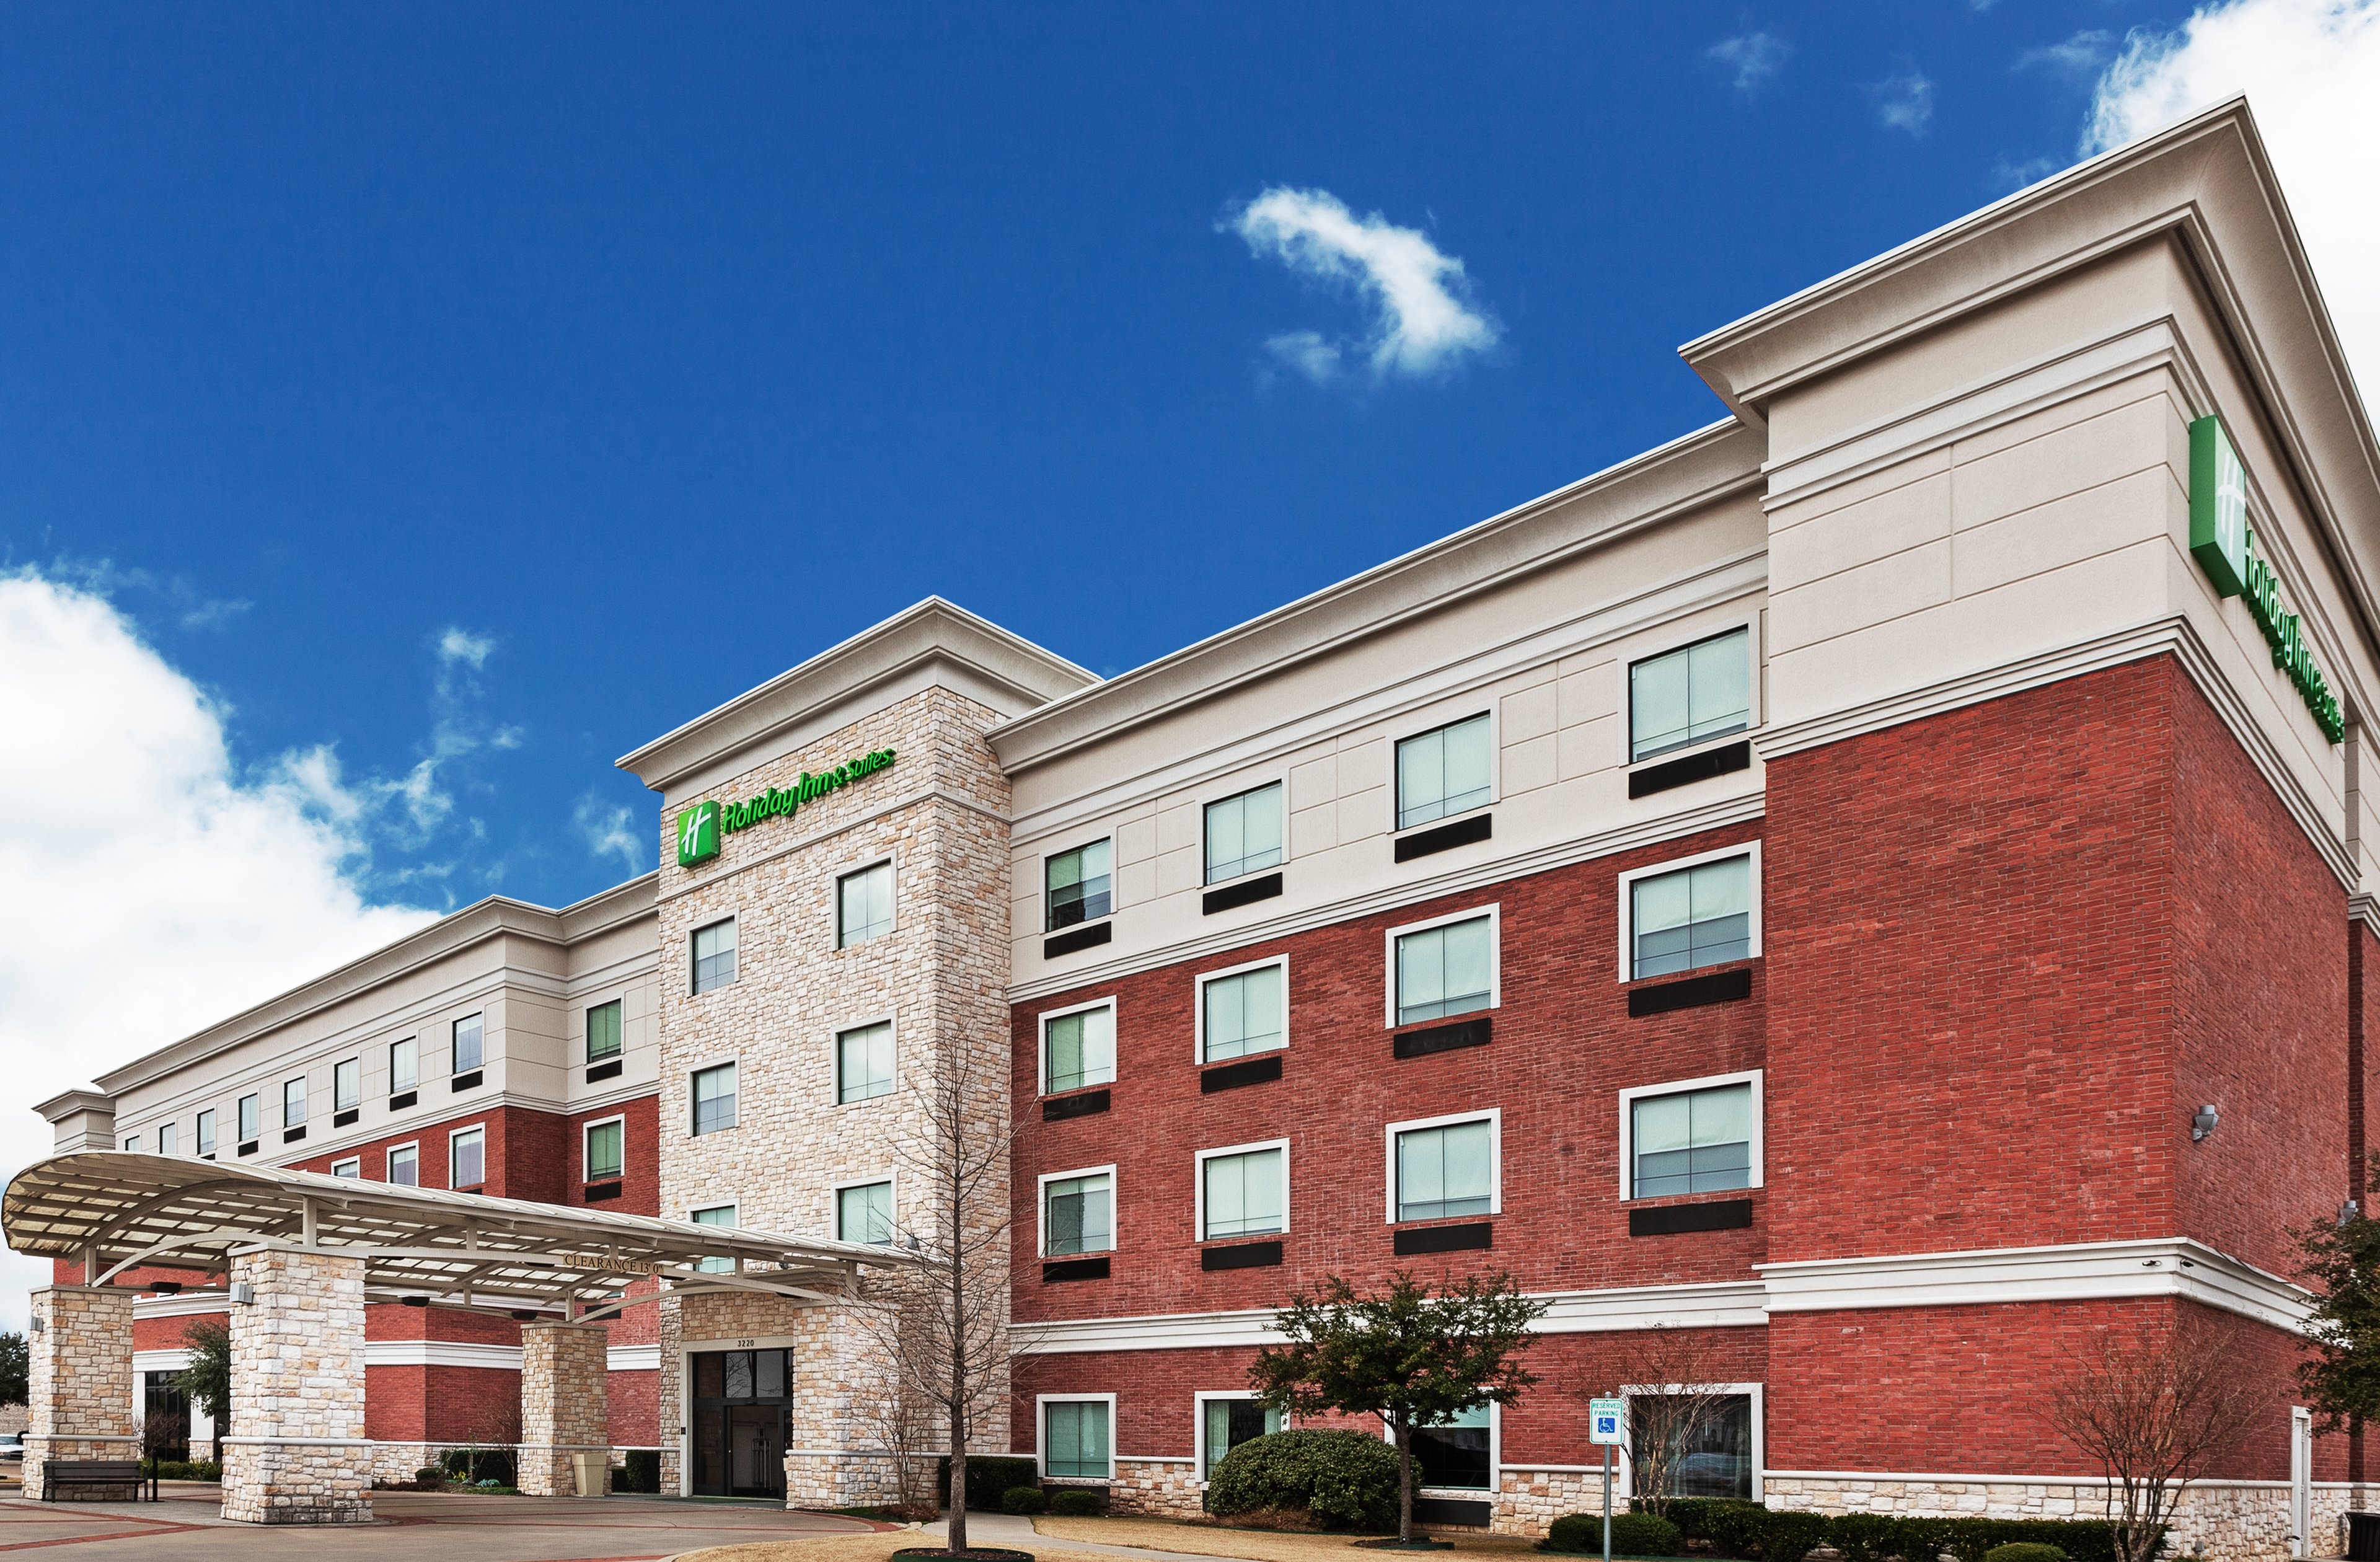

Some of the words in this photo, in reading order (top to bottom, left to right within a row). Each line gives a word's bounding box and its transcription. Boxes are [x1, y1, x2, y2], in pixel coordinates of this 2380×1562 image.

[723, 787, 799, 834] Holiday
[798, 772, 833, 803] Inn
[832, 766, 846, 787] &
[845, 748, 896, 781] Suites
[565, 1255, 637, 1272] CLEARANCE
[640, 1262, 651, 1273] 13'
[653, 1264, 663, 1274] 0"
[738, 1339, 754, 1348] 3220
